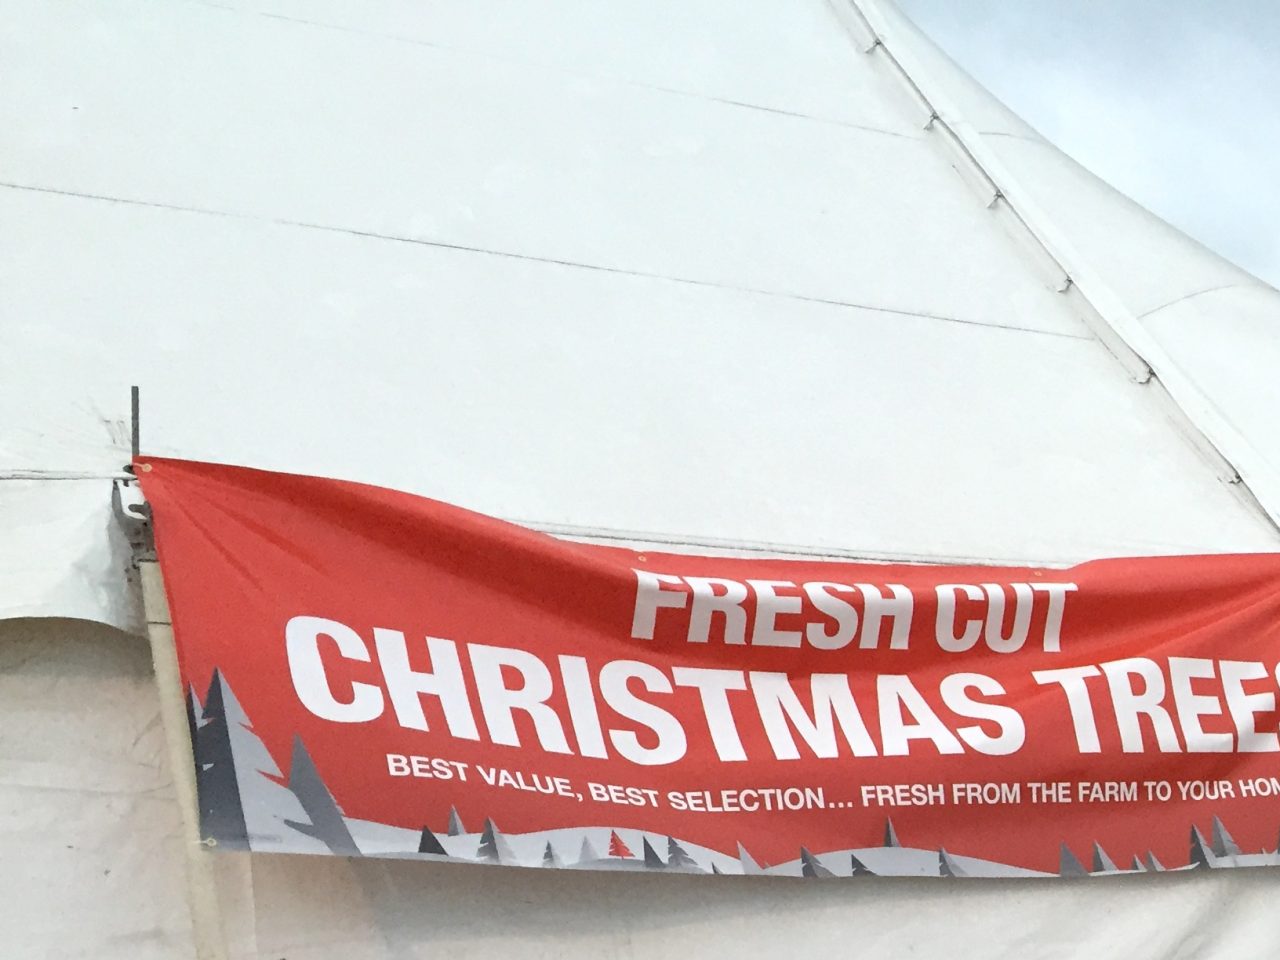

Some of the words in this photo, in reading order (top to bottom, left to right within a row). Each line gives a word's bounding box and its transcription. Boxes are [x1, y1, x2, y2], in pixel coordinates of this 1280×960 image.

[630, 568, 914, 650] FRESH
[934, 581, 1078, 654] CUT
[285, 615, 1026, 766] CHRISTMAS
[386, 753, 469, 782] BEST
[475, 765, 584, 802] VALUE,
[587, 782, 659, 808] BEST
[860, 783, 946, 807] FRESH
[951, 783, 1022, 805] FROM
[1027, 782, 1072, 803] THE
[1078, 781, 1138, 802] FARM
[1143, 780, 1172, 801] TO
[1176, 780, 1236, 801] YOUR
